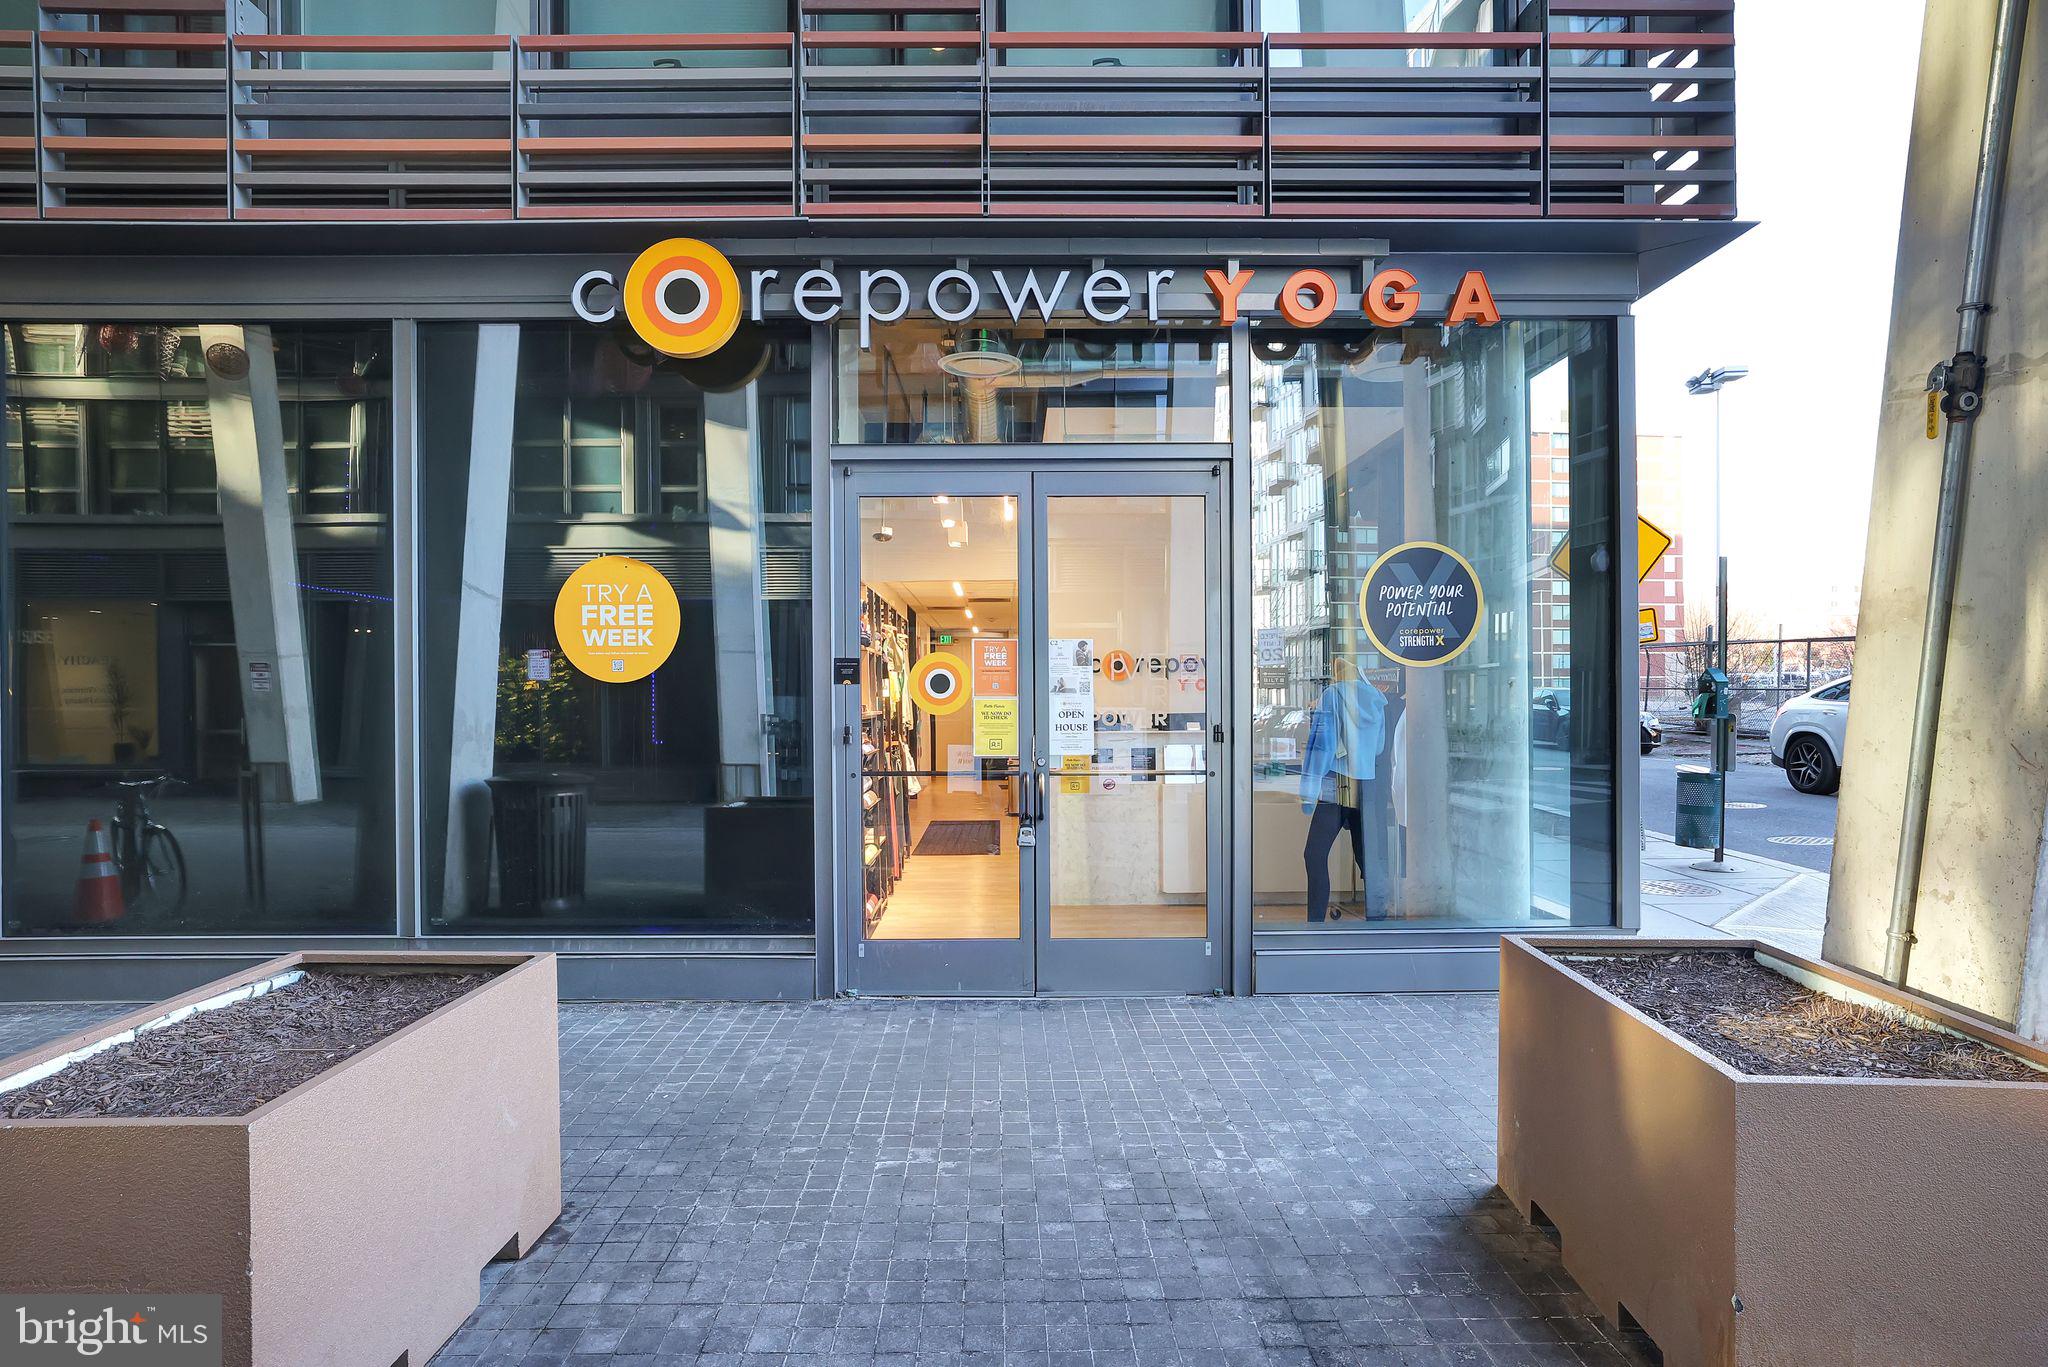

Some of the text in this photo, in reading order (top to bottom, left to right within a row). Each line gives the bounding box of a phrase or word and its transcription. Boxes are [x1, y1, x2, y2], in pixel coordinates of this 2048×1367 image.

[571, 264, 1501, 353] corepower YOGA
[581, 583, 653, 602] TRY A
[1379, 584, 1464, 601] POWER YOUR
[581, 604, 654, 626] FREE
[1386, 601, 1454, 618] POTENTIAL
[581, 628, 654, 647] WEEK
[1400, 627, 1445, 635] corepower
[940, 635, 952, 645] EXIT
[983, 652, 1007, 660] FREE
[984, 659, 1007, 667] WEEK
[1058, 710, 1085, 719] OPEN
[1055, 723, 1089, 732] HOUSE
